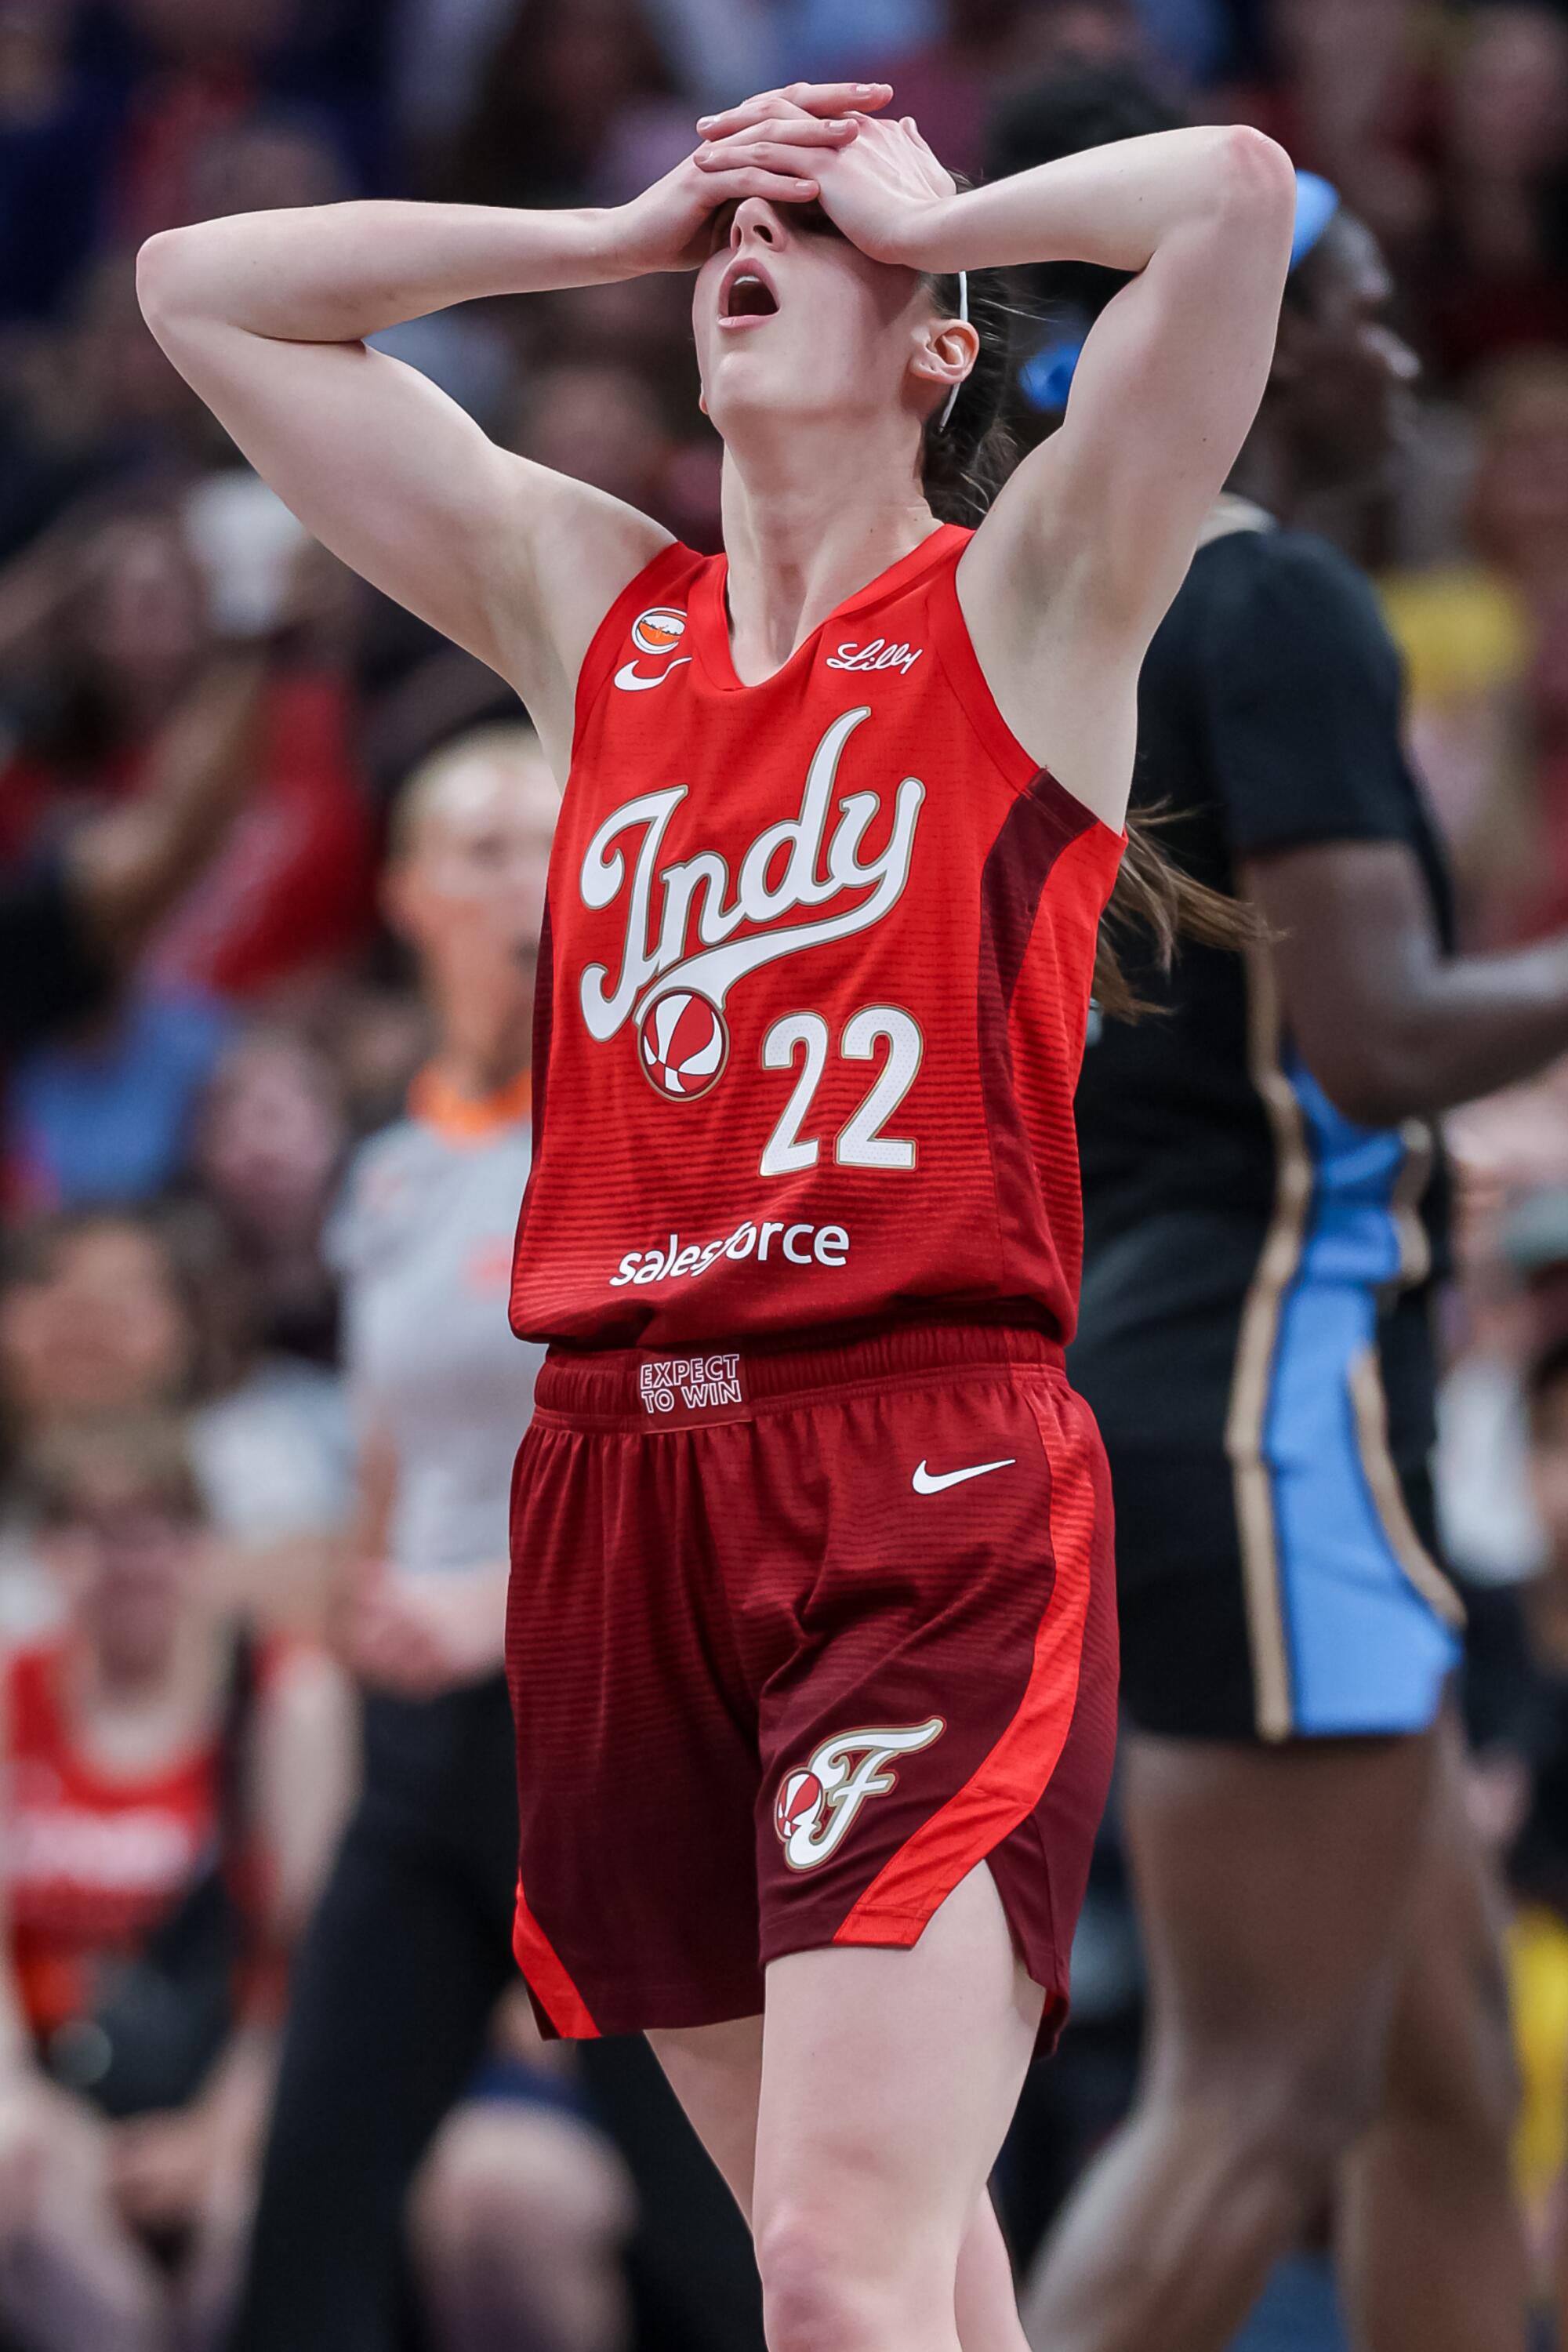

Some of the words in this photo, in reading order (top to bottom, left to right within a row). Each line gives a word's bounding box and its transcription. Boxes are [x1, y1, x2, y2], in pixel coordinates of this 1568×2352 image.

[826, 638, 923, 674] Lilly
[580, 706, 926, 1042] Indy
[758, 1004, 924, 1177] 22
[609, 1221, 850, 1287] salesforce
[640, 1354, 740, 1390] EXPECT
[641, 1388, 675, 1414] TO
[681, 1380, 742, 1409] WIN
